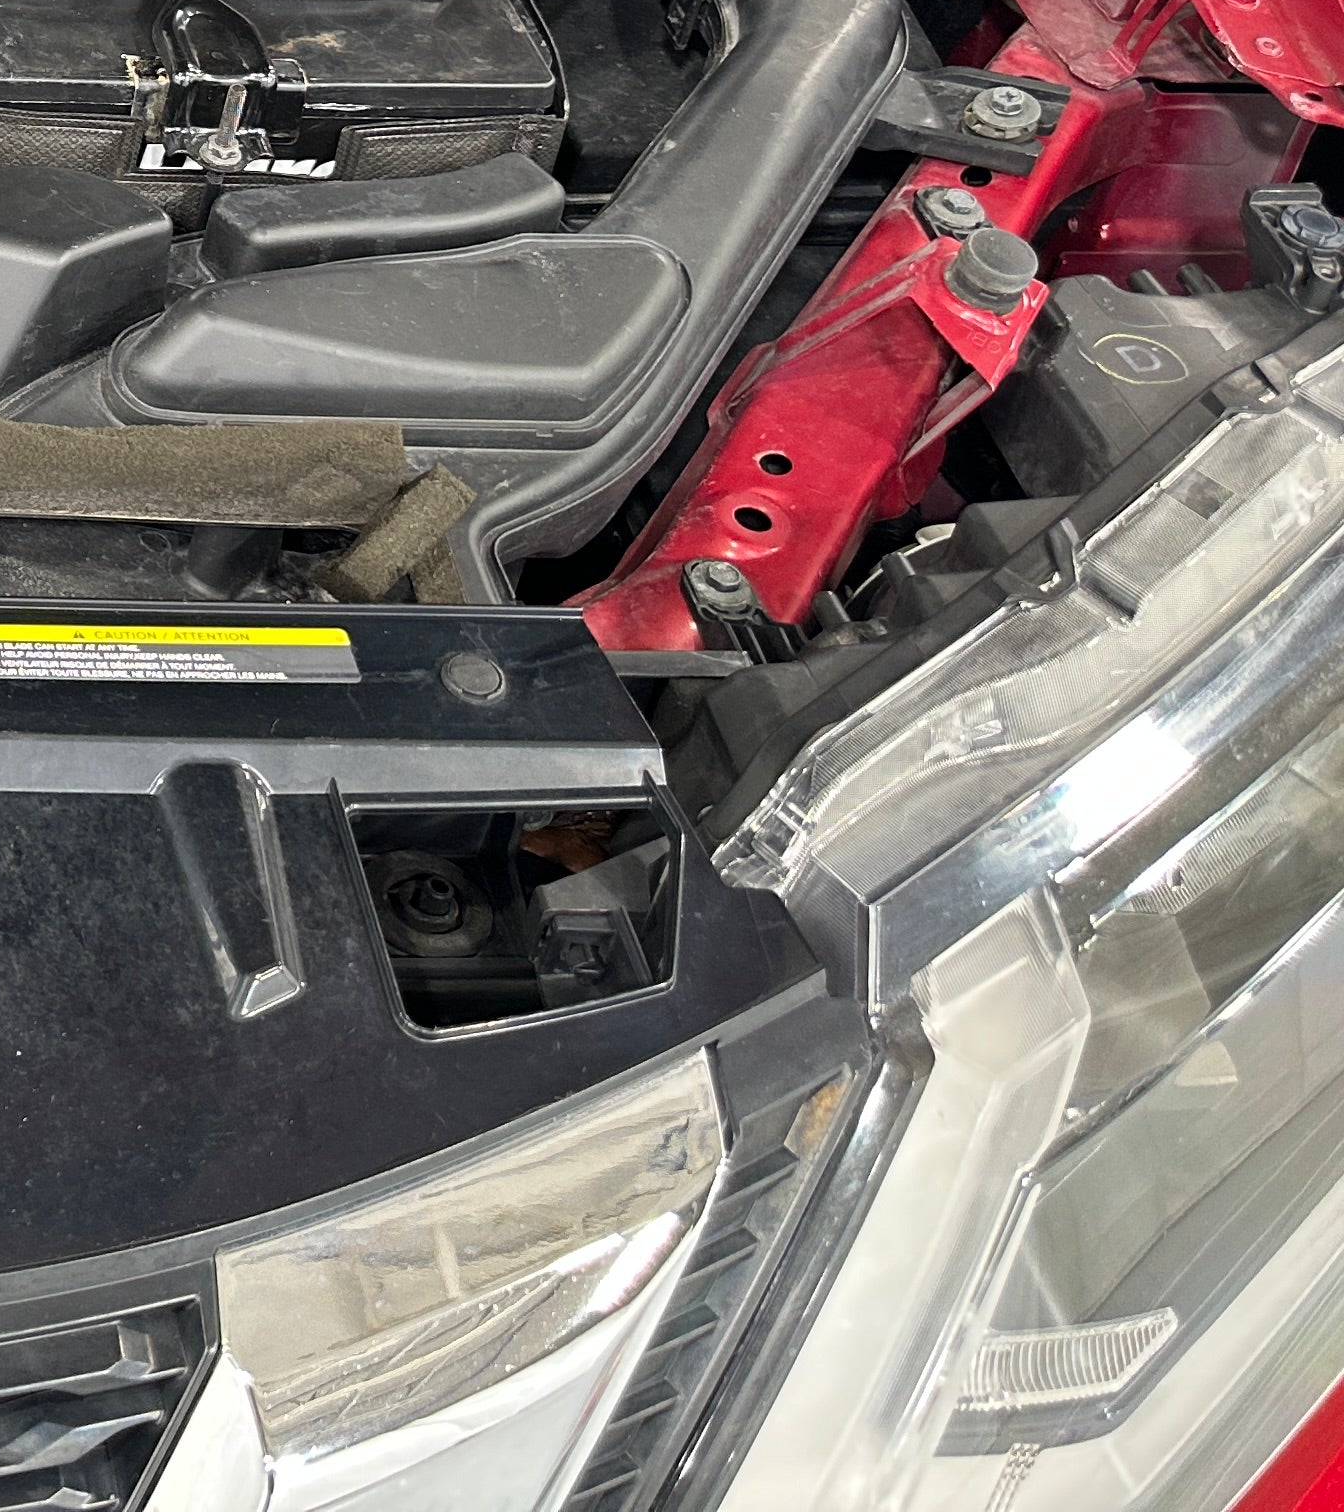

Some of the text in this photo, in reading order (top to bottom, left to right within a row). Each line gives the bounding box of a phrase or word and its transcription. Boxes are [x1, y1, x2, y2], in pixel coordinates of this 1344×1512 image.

[94, 630, 157, 640] CAUTION
[173, 631, 250, 642] ATTENTION
[3, 642, 33, 650] BLADE
[34, 643, 55, 651] CAN
[56, 643, 84, 651] START
[1, 651, 24, 659] HELP
[26, 651, 54, 659] AVOID
[55, 651, 103, 660] PERSONAL
[135, 653, 158, 661] KEEP
[159, 653, 192, 661] HANDS
[2, 660, 60, 669] VENTILATEUR
[61, 661, 94, 669] RISQUE
[169, 662, 192, 670] TOUT
[18, 667, 49, 677] ÉVITER
[51, 669, 80, 677] TOUTE
[132, 670, 145, 678] NE
[237, 672, 254, 680] LES
